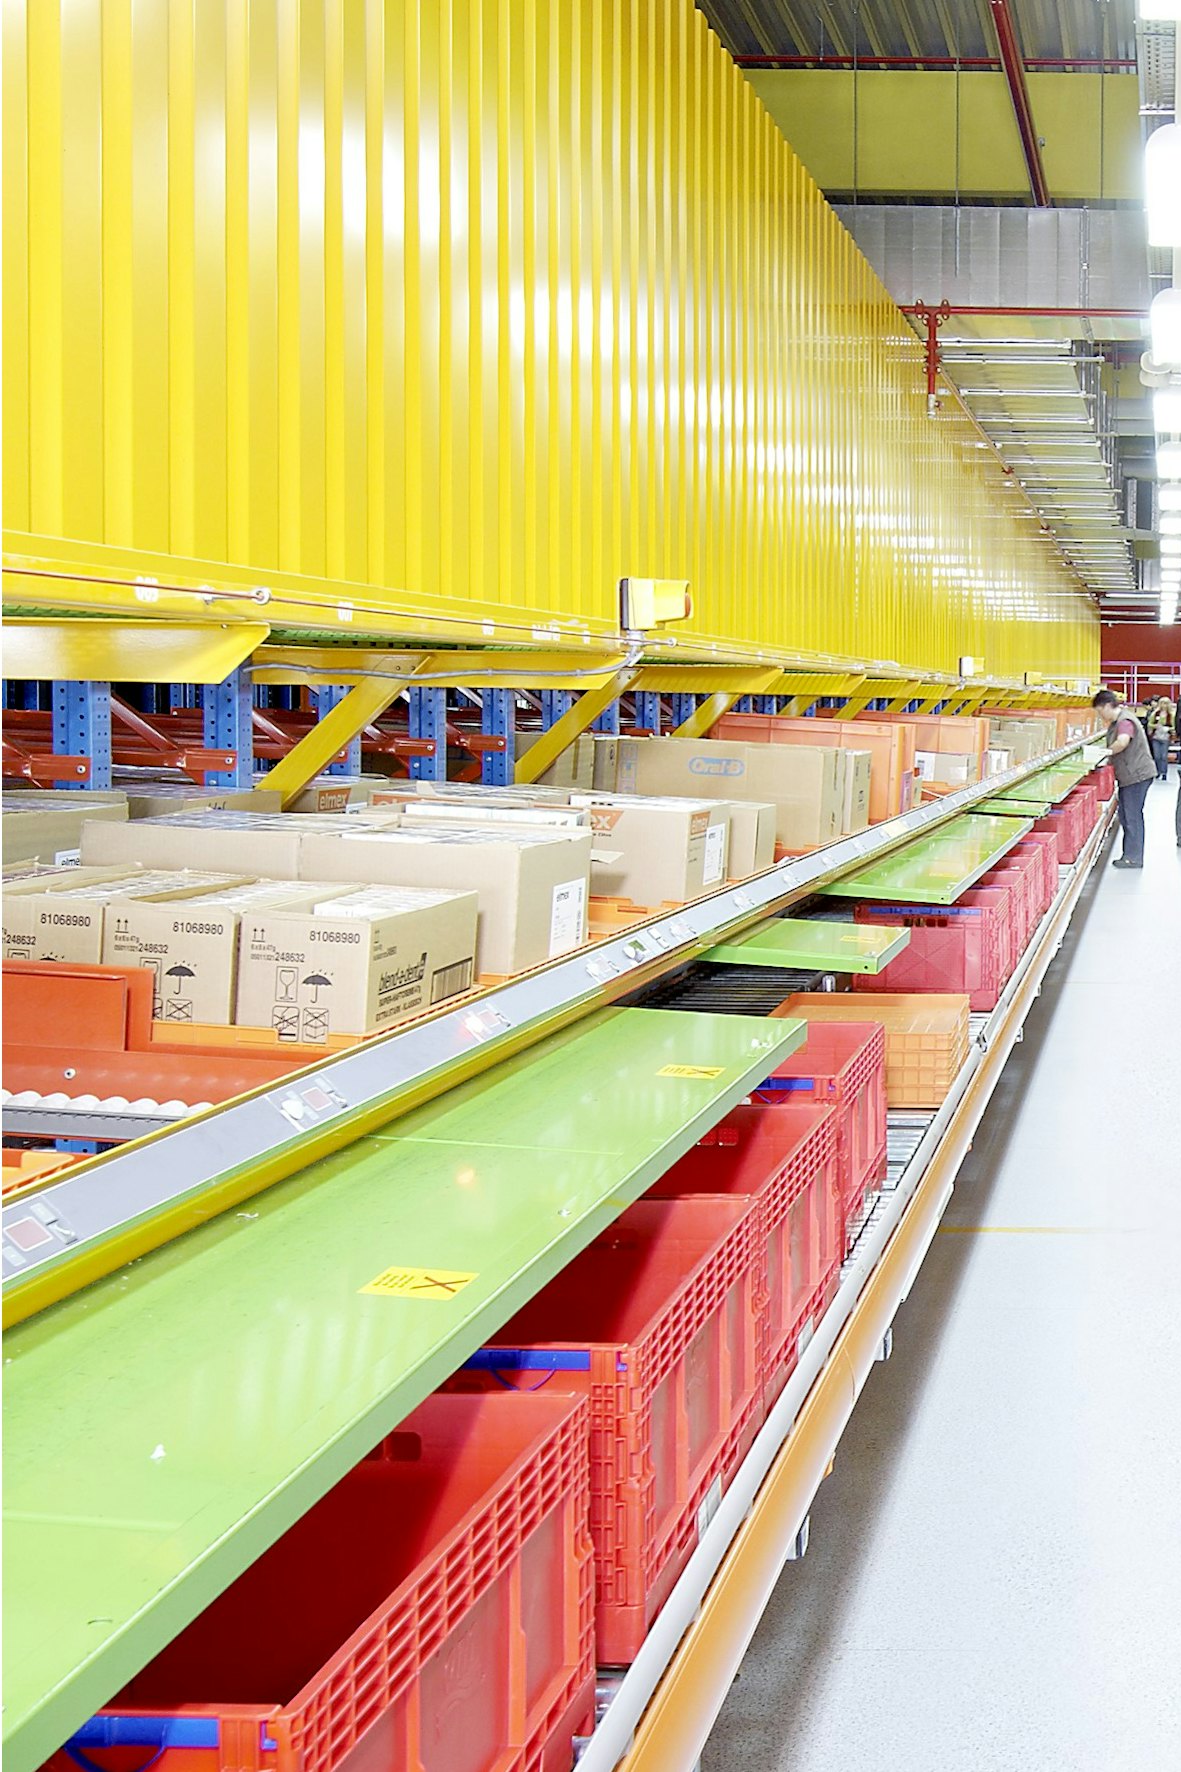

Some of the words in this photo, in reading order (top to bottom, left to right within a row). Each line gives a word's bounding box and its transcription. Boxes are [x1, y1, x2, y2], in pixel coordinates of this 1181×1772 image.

[318, 791, 347, 811] elmex
[40, 913, 91, 927] 81068980
[172, 921, 224, 935] 81068980
[309, 930, 361, 944] 81068980
